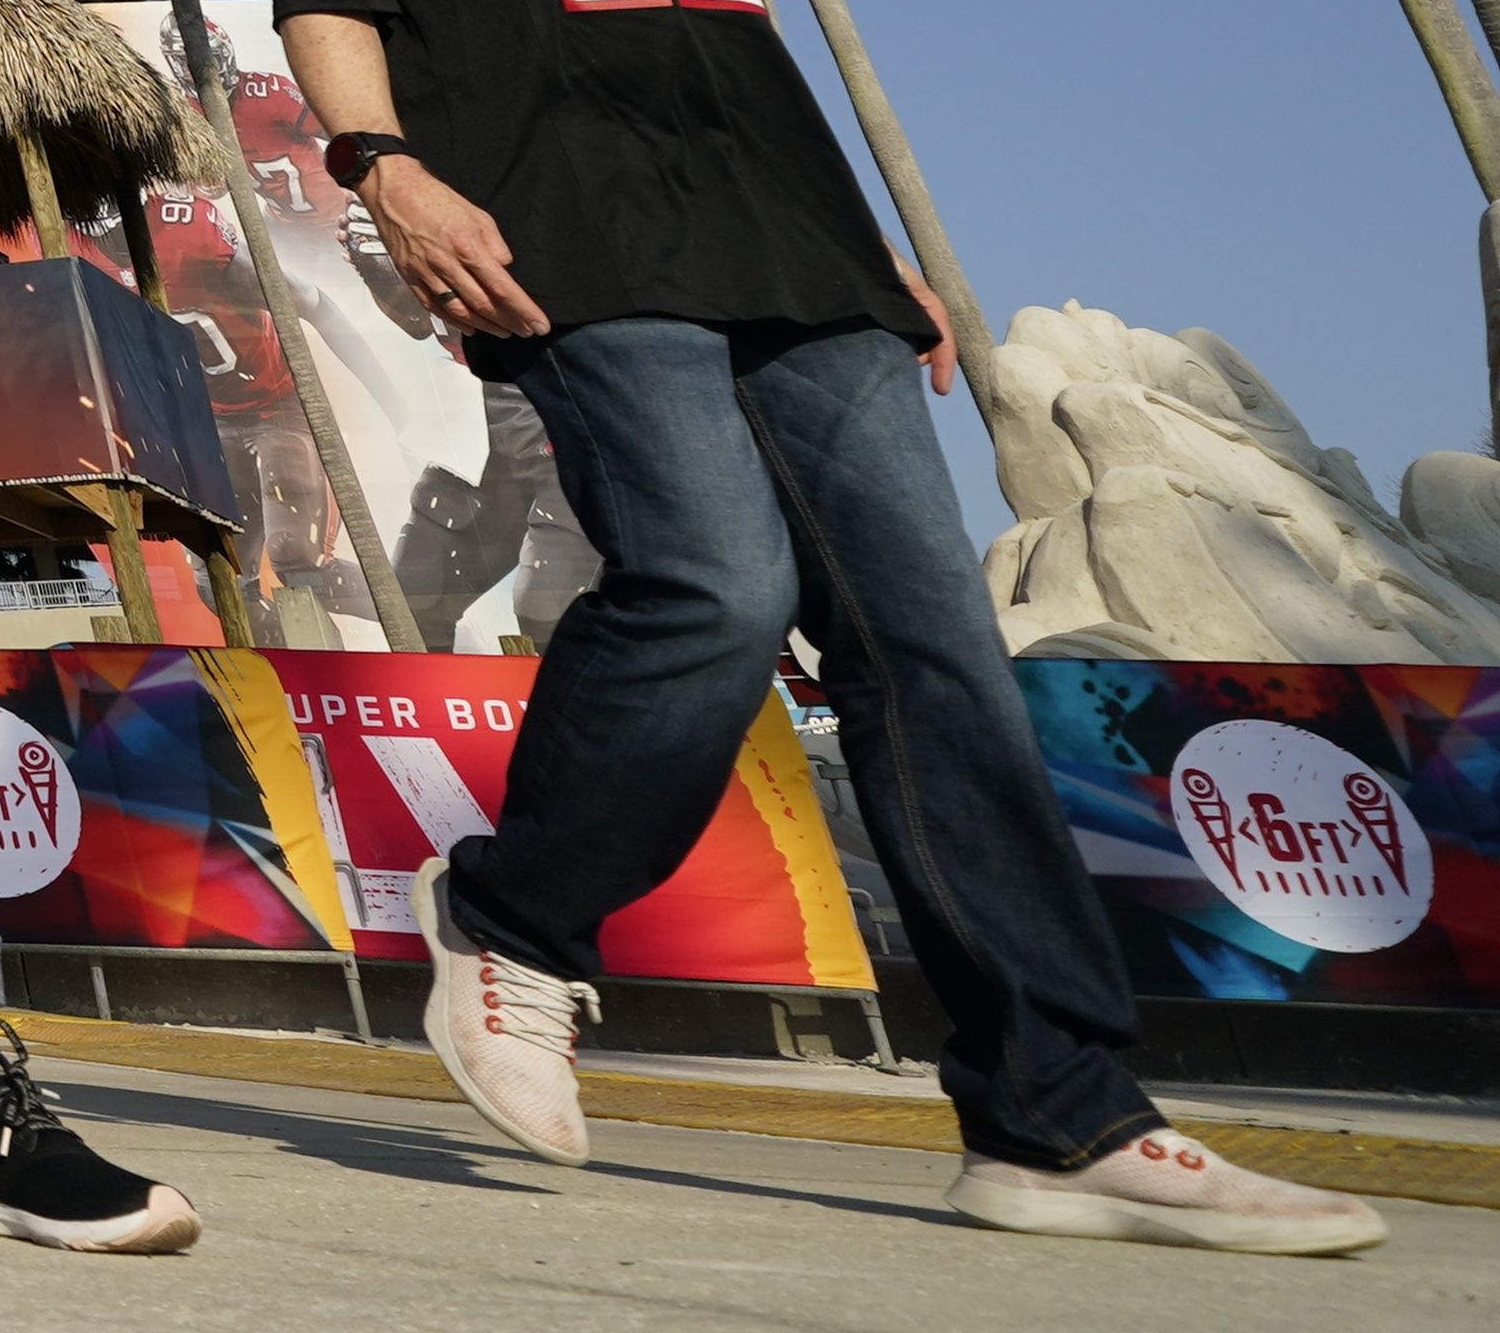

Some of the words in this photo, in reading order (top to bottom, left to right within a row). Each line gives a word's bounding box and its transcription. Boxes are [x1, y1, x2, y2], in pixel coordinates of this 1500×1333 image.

[289, 692, 421, 730] UPER
[445, 695, 526, 732] BO
[1246, 792, 1350, 866] 6FT
